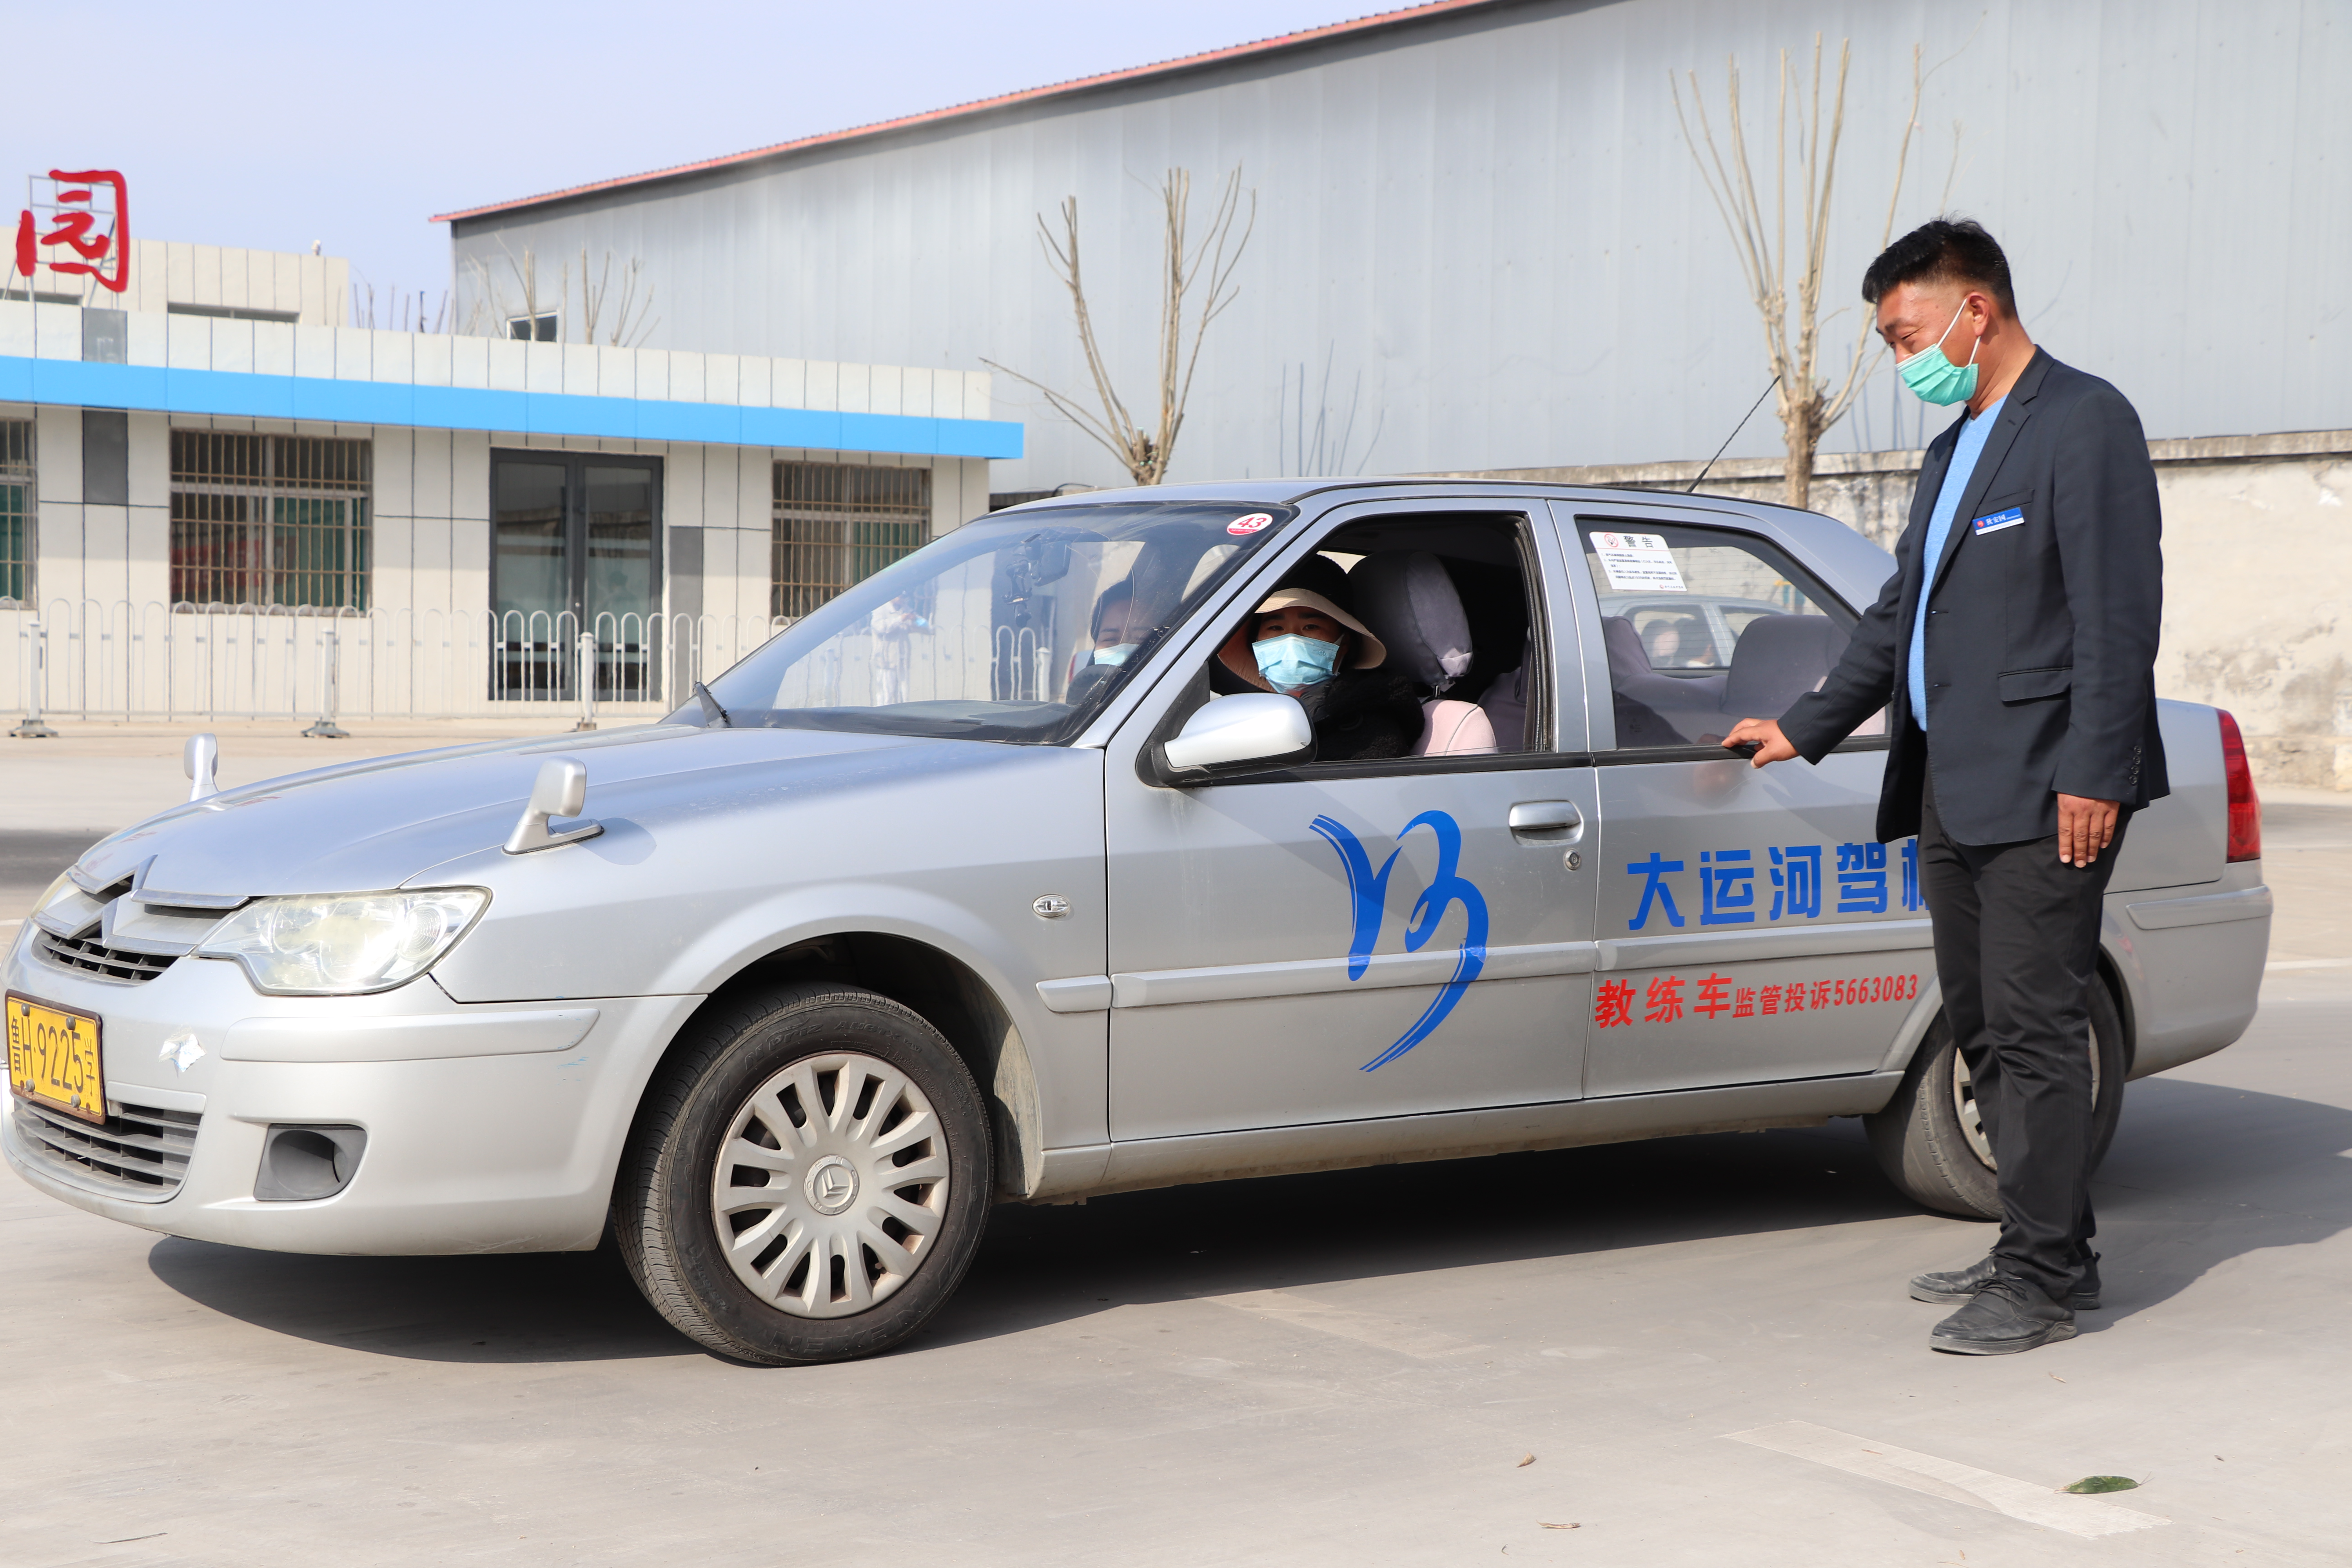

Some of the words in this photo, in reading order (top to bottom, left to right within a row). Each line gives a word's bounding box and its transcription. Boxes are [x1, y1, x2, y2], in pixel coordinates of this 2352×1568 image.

[16, 170, 130, 293] 园
[1237, 517, 1267, 528] 43
[1623, 535, 1654, 548] 警告
[1627, 838, 1929, 931] 大运河驾
